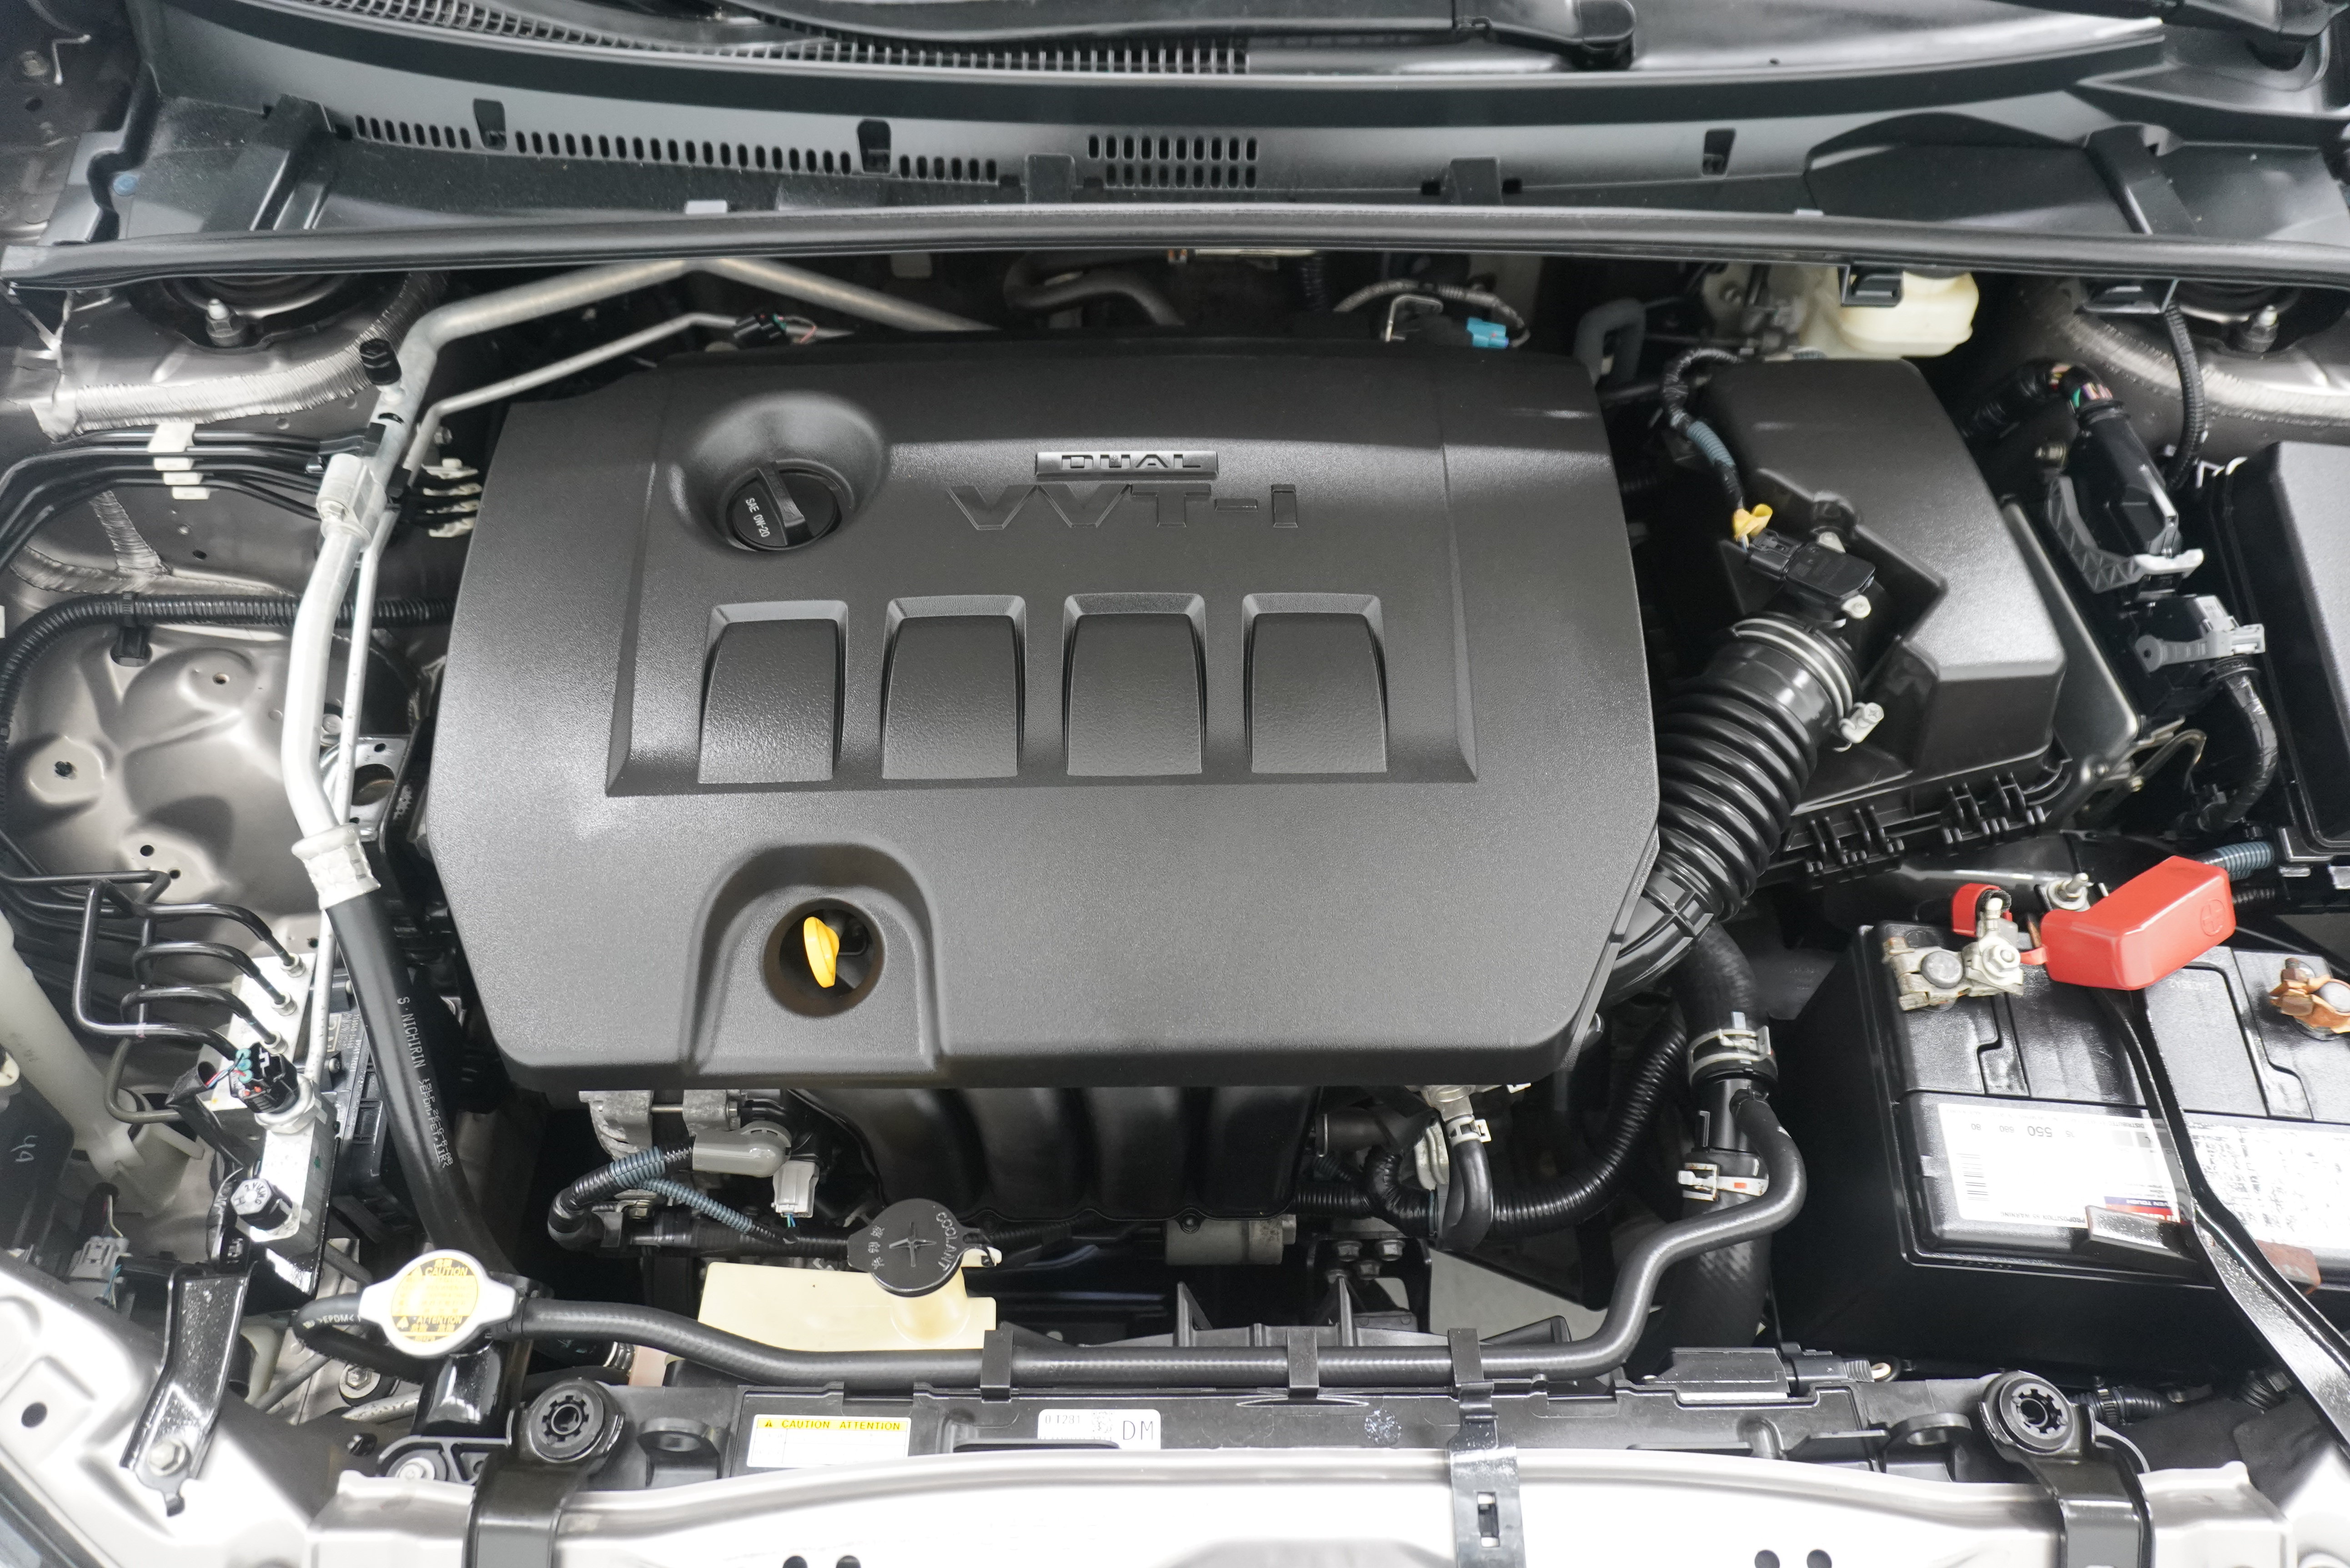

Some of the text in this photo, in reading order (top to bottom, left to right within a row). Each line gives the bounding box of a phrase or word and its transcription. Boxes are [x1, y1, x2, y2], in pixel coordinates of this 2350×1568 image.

[1060, 453, 1202, 470] DUAL
[745, 498, 770, 538] SAE 0W-20
[401, 1013, 426, 1068] NICHIRIN
[432, 1109, 454, 1165] 26-G-R-AB
[1999, 1125, 2014, 1133] 680
[2027, 1126, 2052, 1137] 550
[936, 1212, 958, 1271] COOLANT
[425, 1266, 468, 1276] CAUTION
[416, 1316, 463, 1325] ATTENTION
[782, 1420, 900, 1431] CAUTION ATTENTION
[1122, 1420, 1154, 1441] DM
